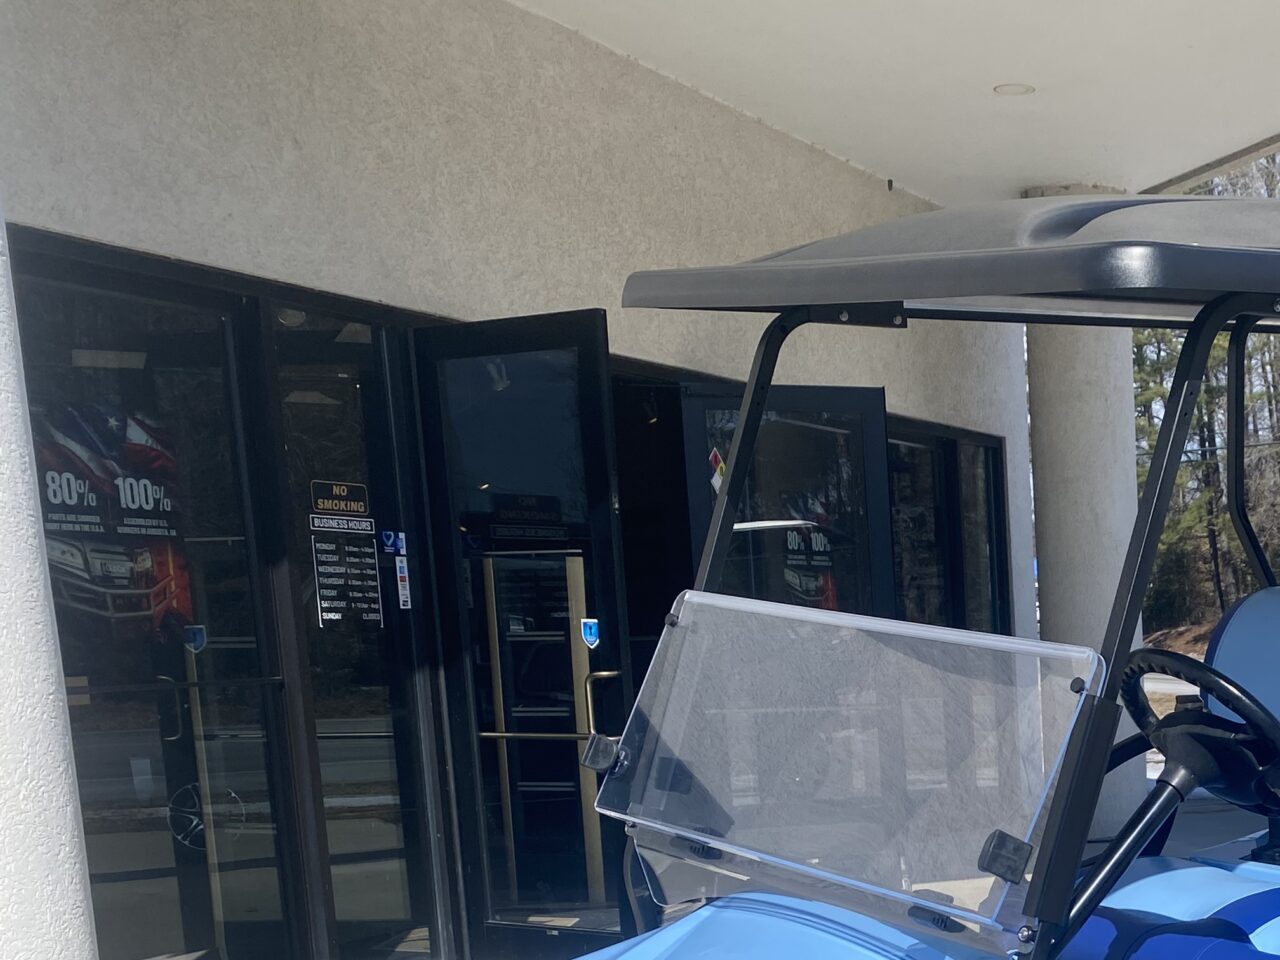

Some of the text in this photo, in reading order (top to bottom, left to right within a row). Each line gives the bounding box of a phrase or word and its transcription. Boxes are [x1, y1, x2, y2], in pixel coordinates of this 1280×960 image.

[45, 471, 171, 512] 80% 100%
[332, 485, 347, 496] NO
[317, 499, 365, 512] SMOKING
[313, 518, 371, 531] BUSINESS HOURS
[315, 542, 336, 551] MONDAY
[316, 553, 339, 562] TUESDAY
[318, 565, 346, 573] WEDNESDAY
[319, 577, 345, 585] THURSDAY
[320, 589, 338, 597] FRIDAY
[321, 600, 347, 608] SATURDAY
[322, 612, 342, 620] SUNDAY
